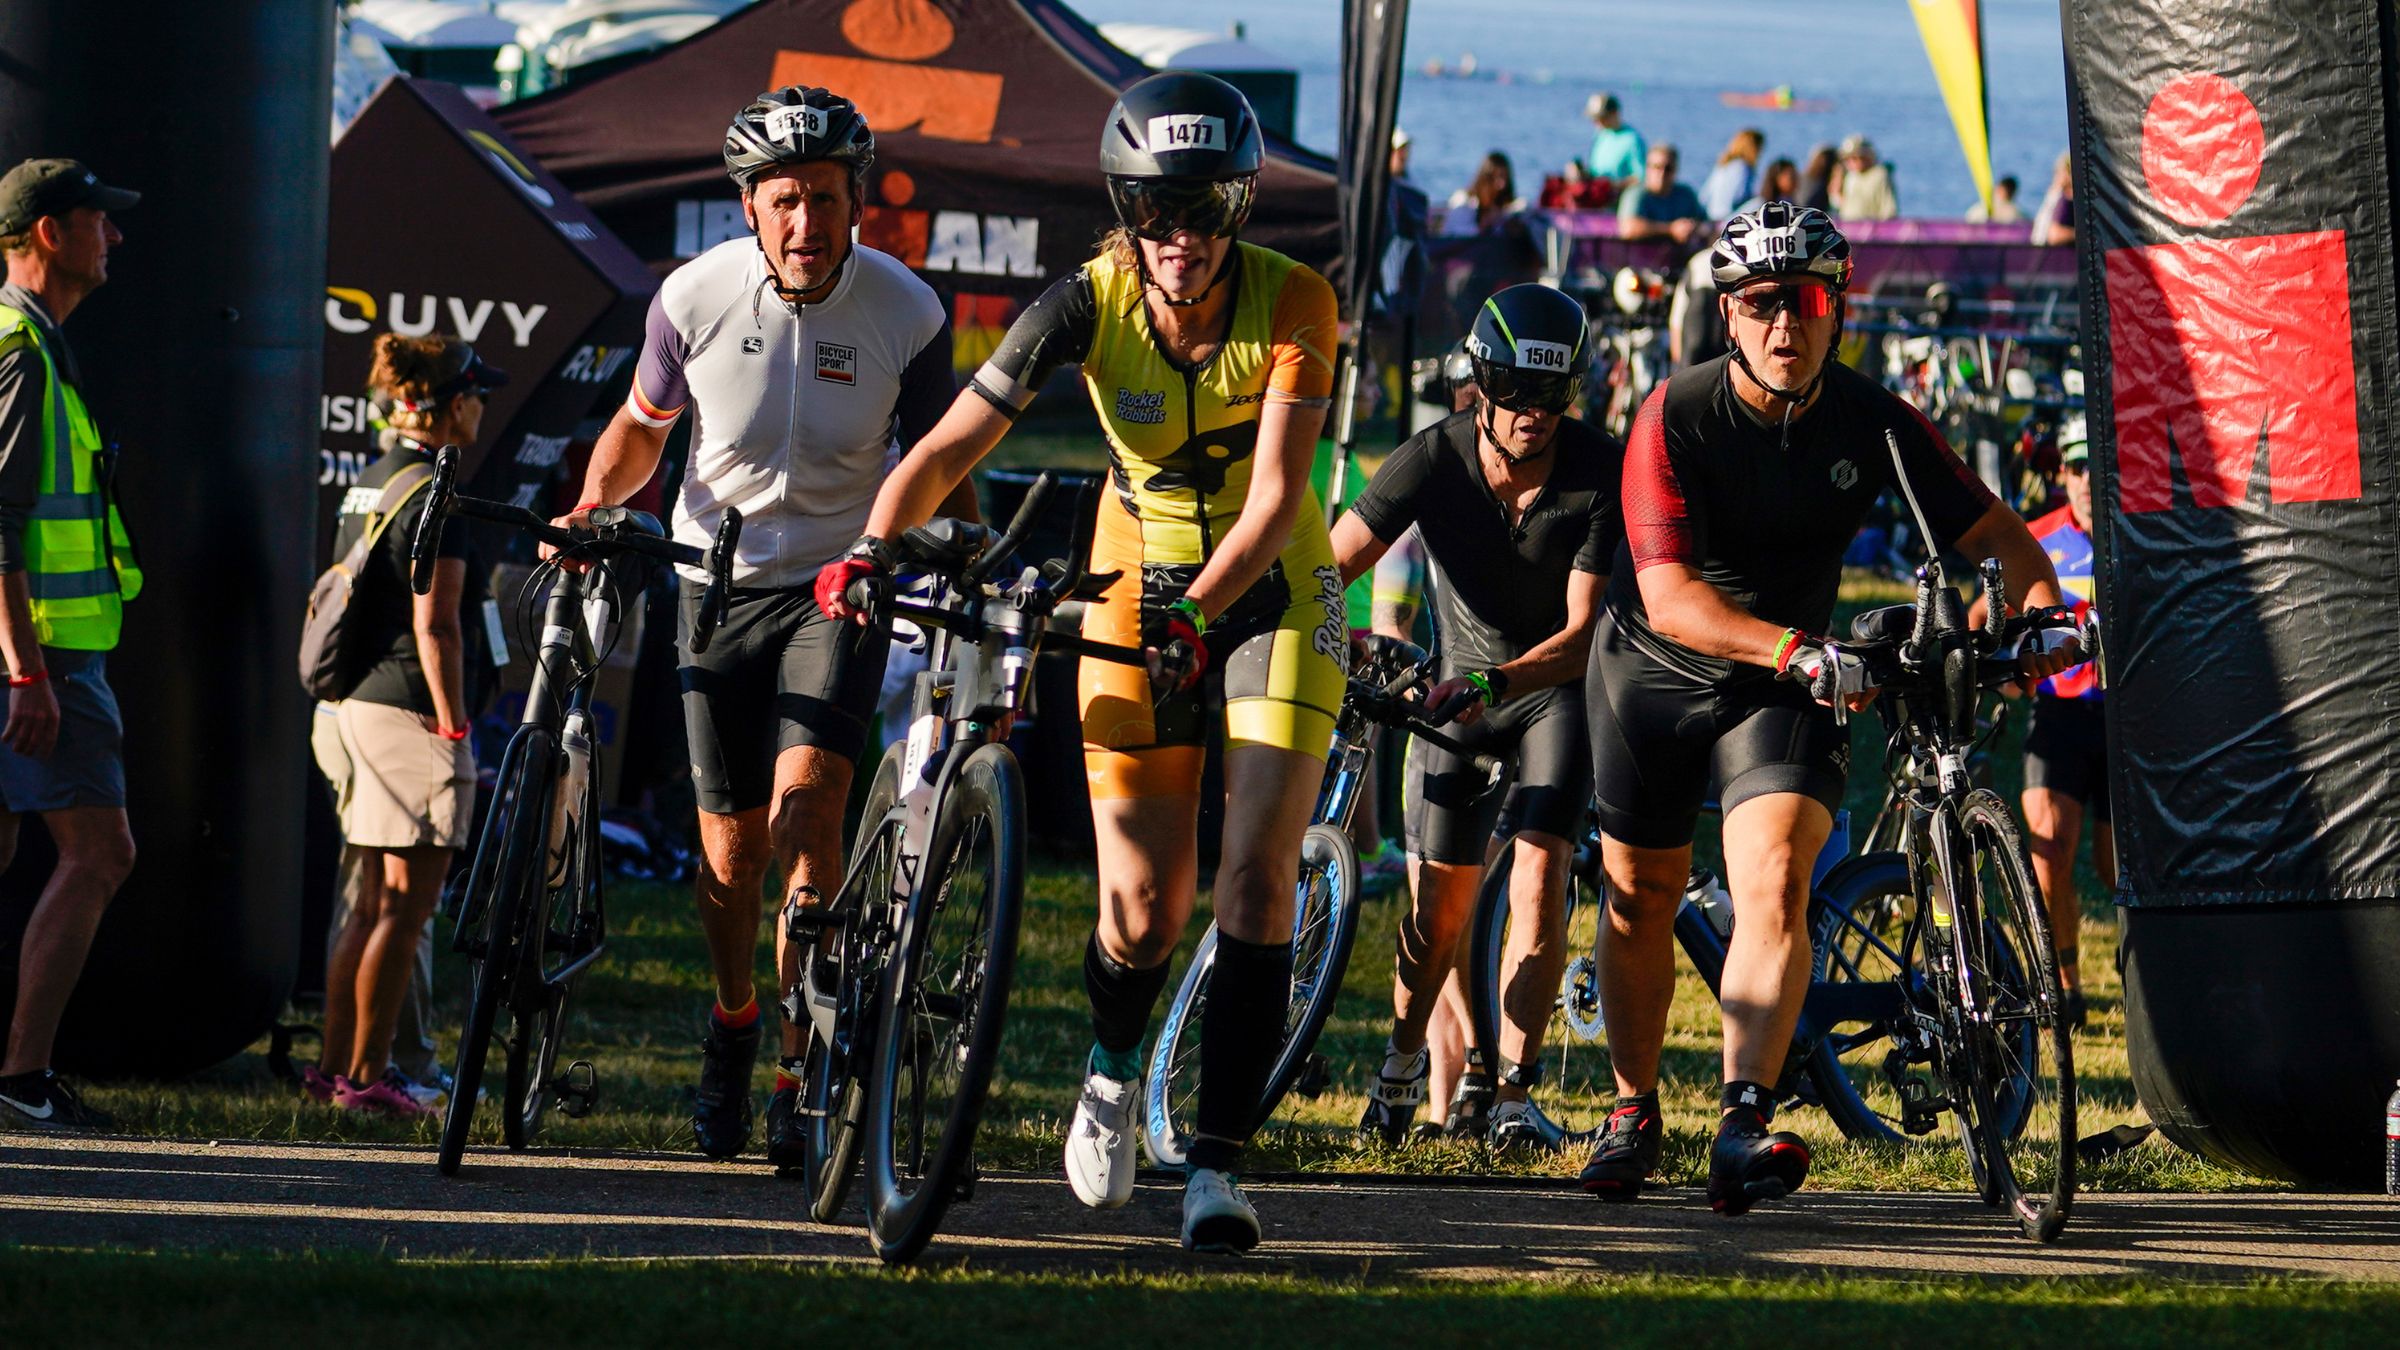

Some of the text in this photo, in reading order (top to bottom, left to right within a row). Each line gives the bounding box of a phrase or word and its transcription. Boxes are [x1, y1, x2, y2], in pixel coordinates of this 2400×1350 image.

[775, 111, 819, 132] 1538
[1166, 122, 1213, 145] 1477
[818, 345, 854, 361] BICYCLE
[818, 356, 846, 371] SPORT
[1525, 346, 1565, 369] 1504
[1117, 387, 1165, 408] Rocket
[1116, 403, 1166, 424] Rabbits
[1542, 508, 1571, 520] ROKA
[1313, 565, 1343, 667] Rocket
